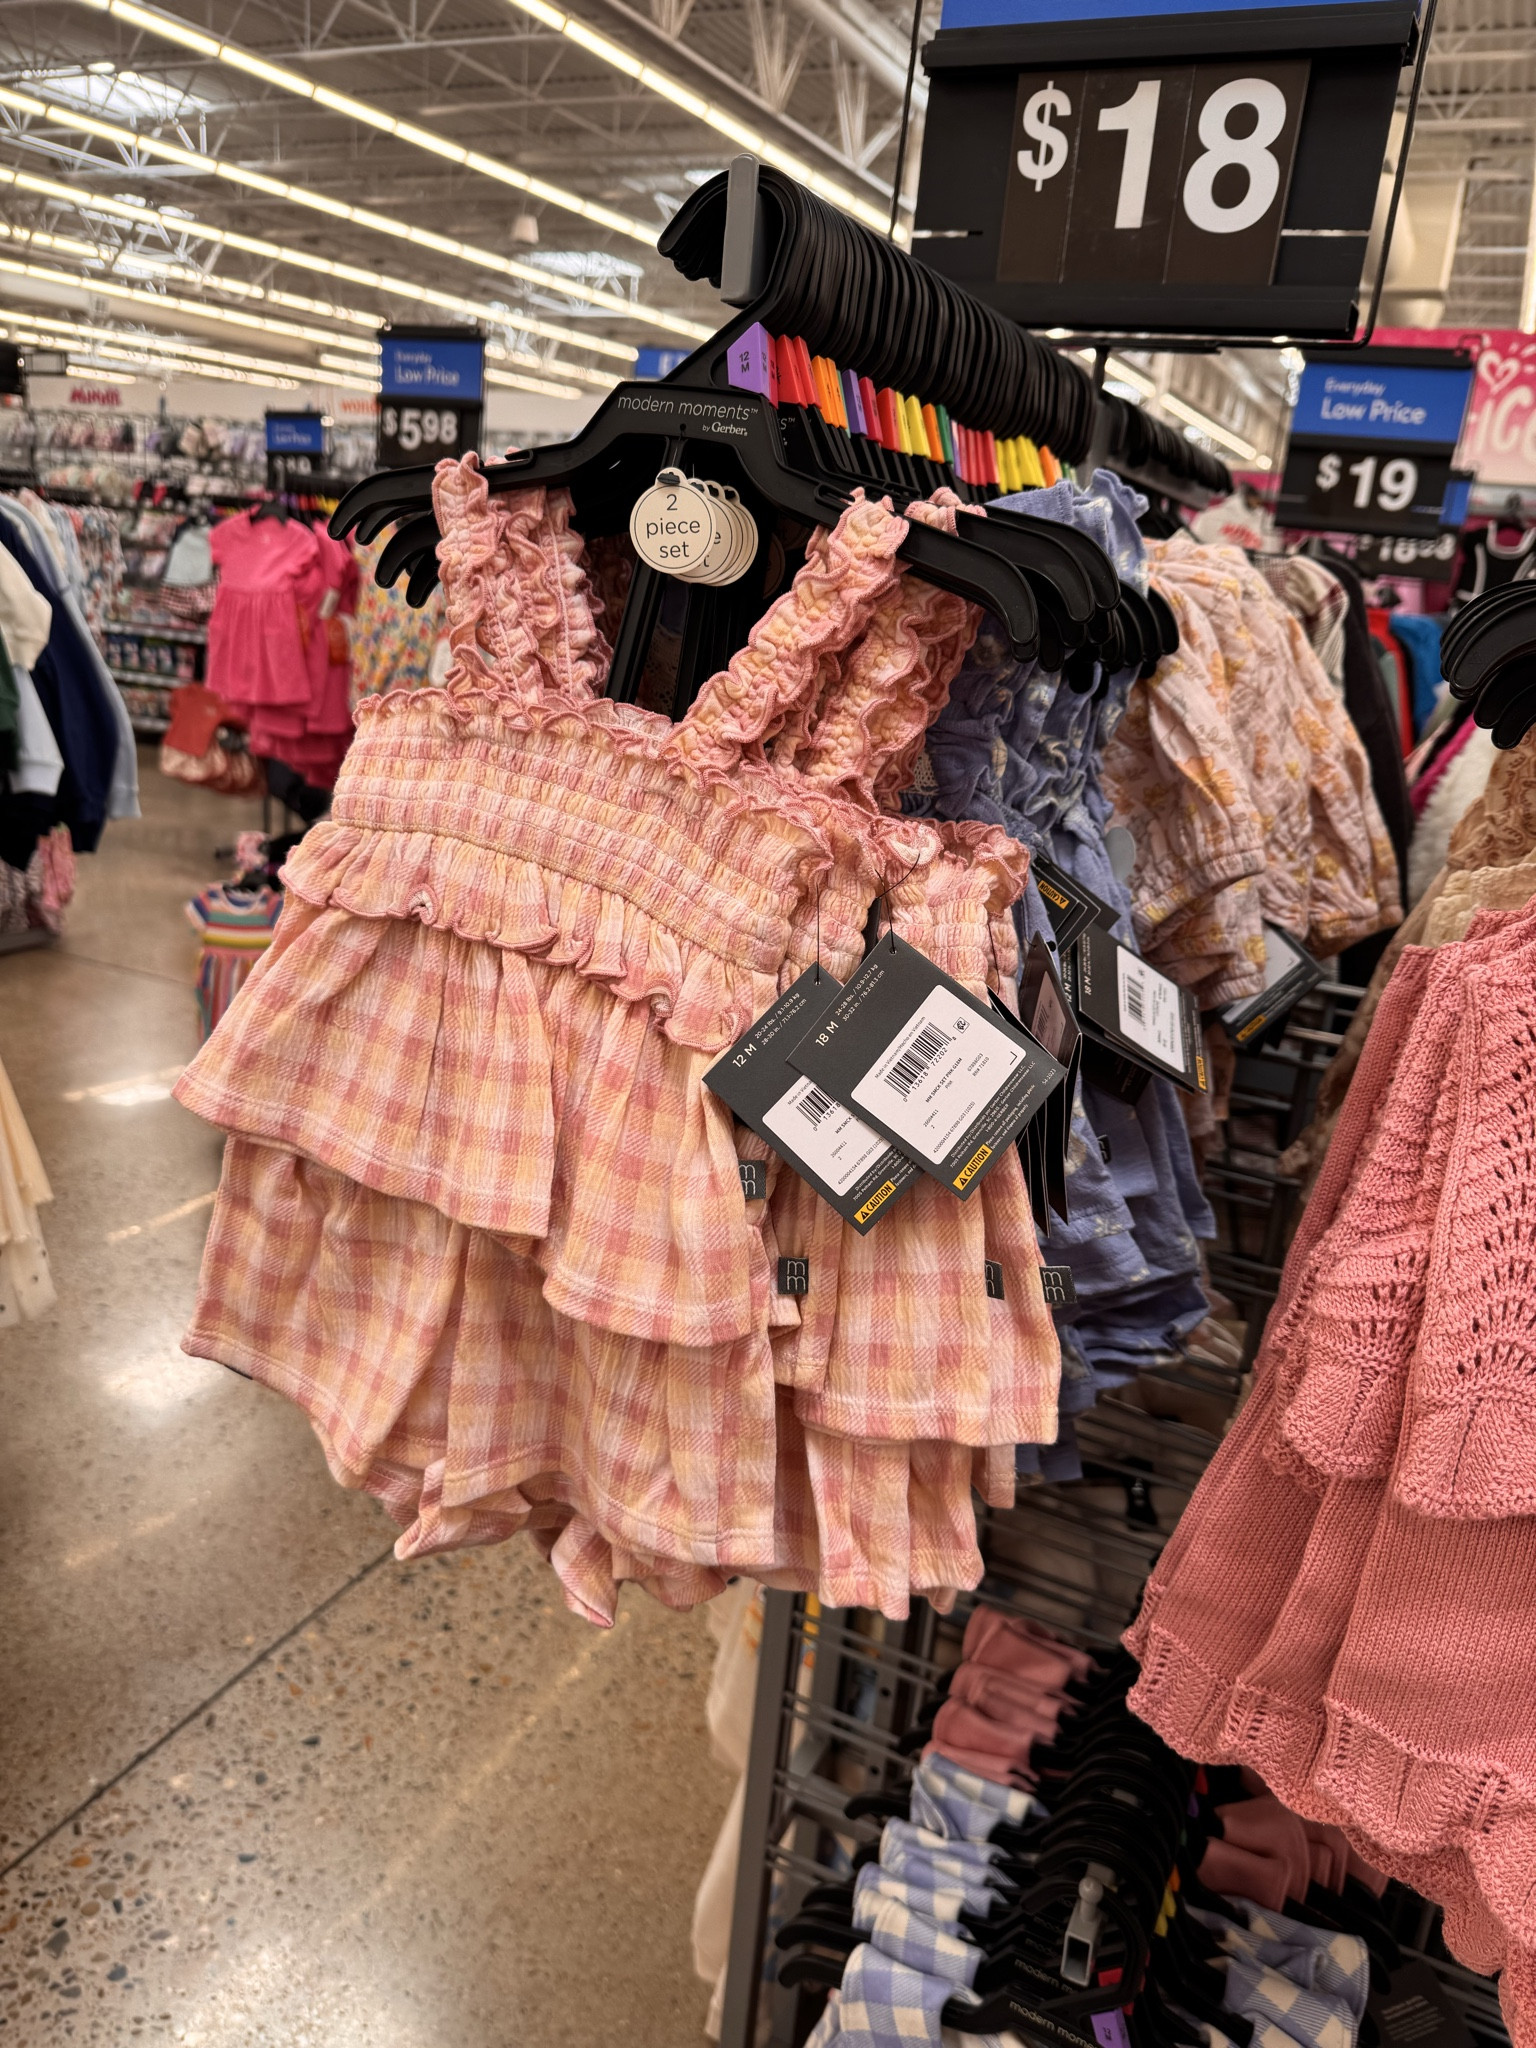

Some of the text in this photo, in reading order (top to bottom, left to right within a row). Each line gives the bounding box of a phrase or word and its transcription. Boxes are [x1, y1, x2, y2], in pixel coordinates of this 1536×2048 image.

[1016, 78, 1287, 234] $18
[739, 351, 750, 362] 12
[395, 365, 460, 387] Low Price
[741, 362, 750, 373] M
[1324, 376, 1386, 397] Everyday
[617, 395, 674, 413] modern
[1321, 399, 1427, 425] Low Price
[702, 424, 711, 433] by
[1316, 453, 1418, 512] $19
[666, 493, 678, 511] 2
[646, 518, 701, 539] piece
[660, 541, 690, 558] set
[815, 1032, 830, 1047] 18
[825, 1020, 839, 1034] M
[870, 963, 879, 972] kg
[911, 1016, 926, 1032] Vietnam
[732, 1054, 747, 1068] 12
[743, 1043, 757, 1057] M
[911, 1071, 929, 1090] 13618
[930, 1047, 948, 1067] 72202
[822, 1101, 842, 1121] 13618
[963, 1148, 989, 1177] CAUTION
[866, 1184, 893, 1212] CAUTION
[1009, 2000, 1055, 2031] modern
